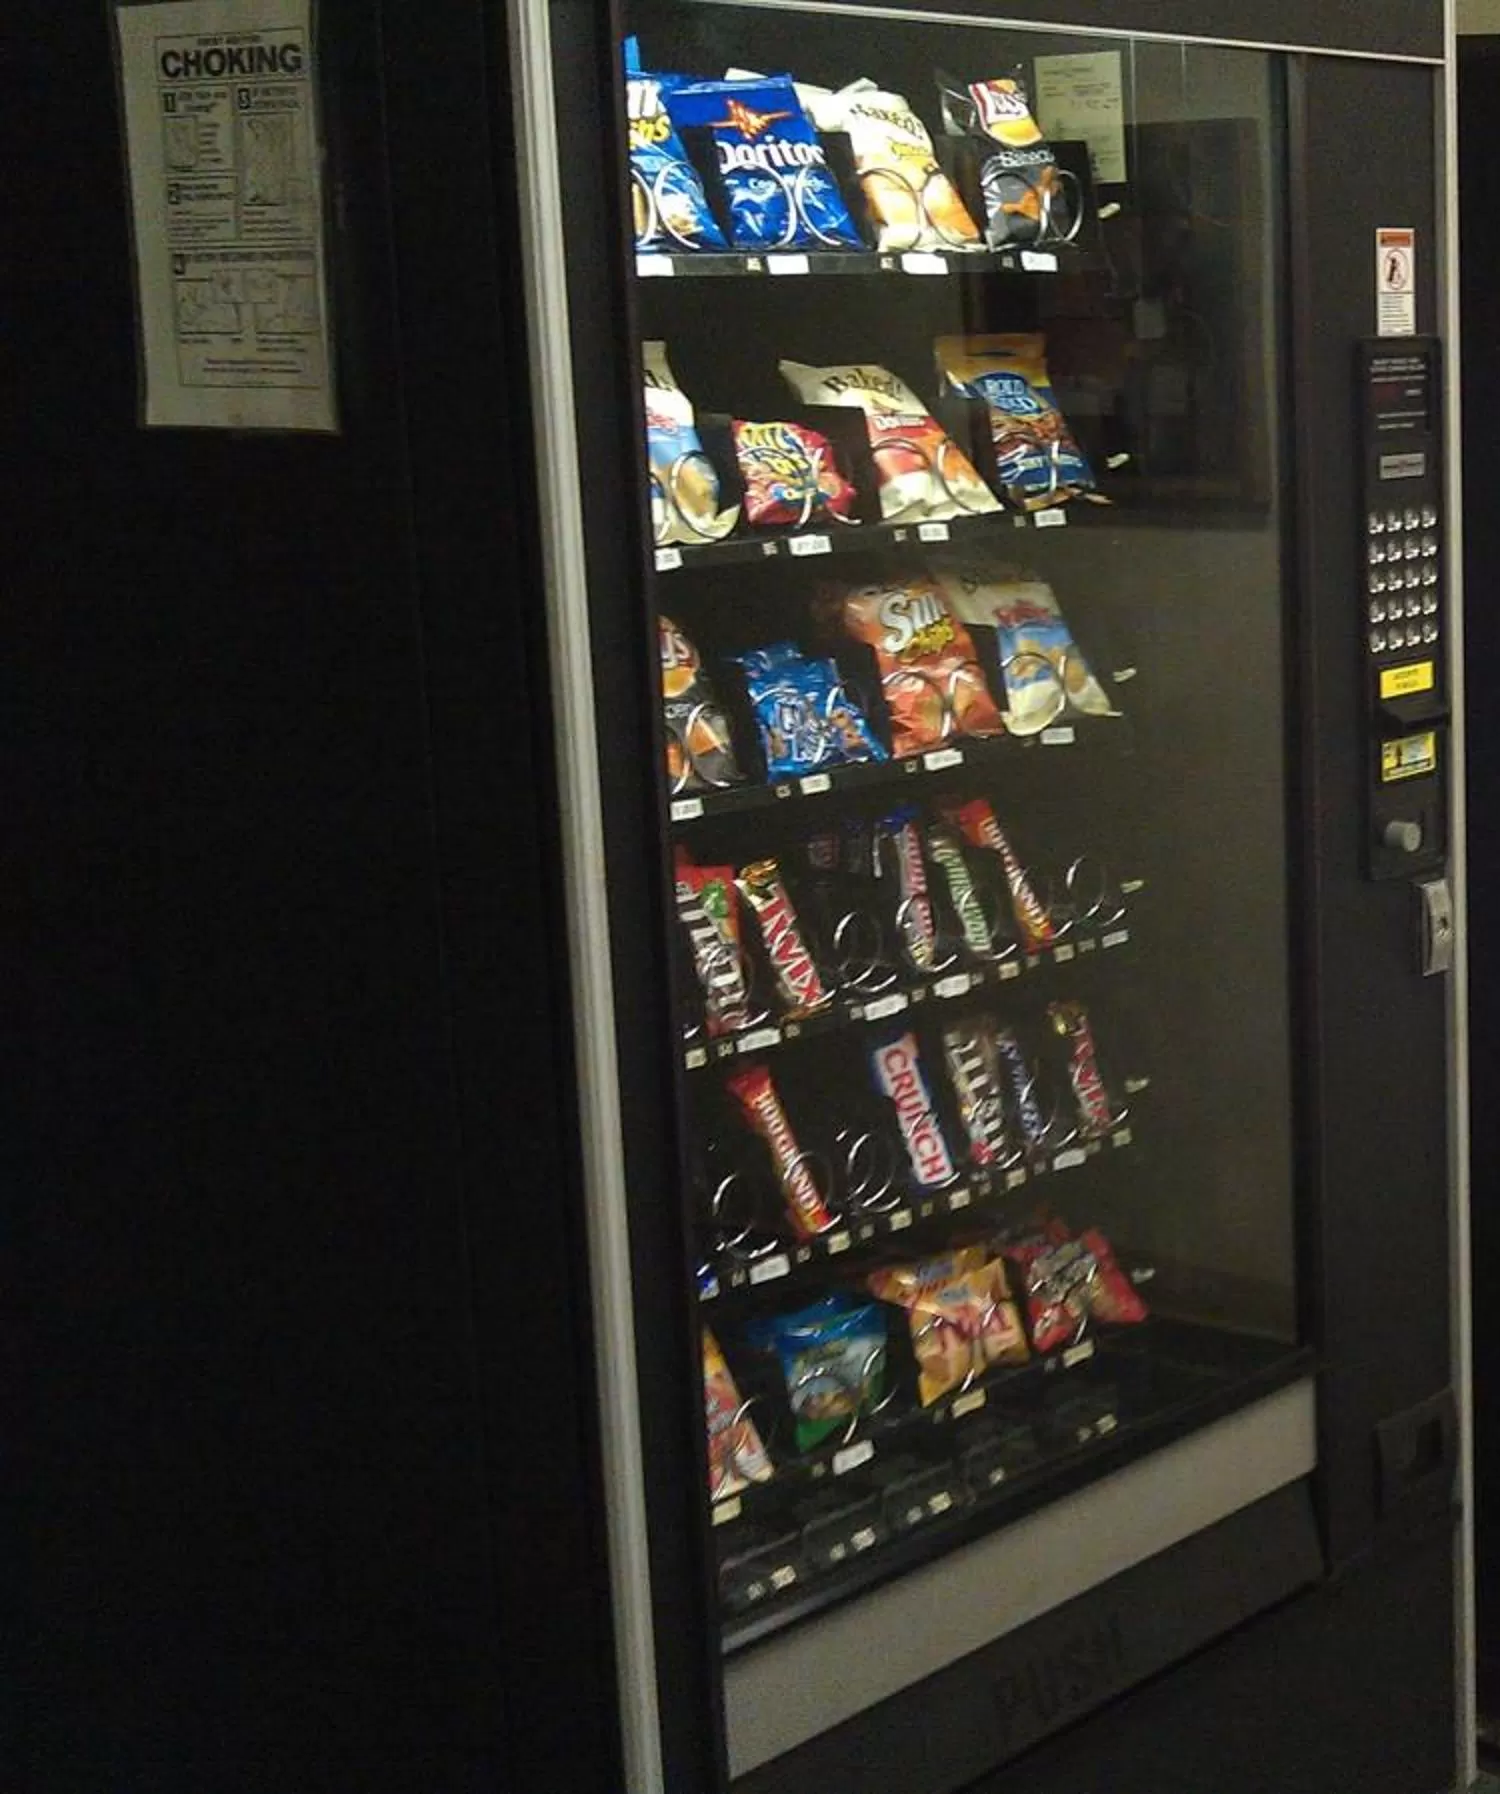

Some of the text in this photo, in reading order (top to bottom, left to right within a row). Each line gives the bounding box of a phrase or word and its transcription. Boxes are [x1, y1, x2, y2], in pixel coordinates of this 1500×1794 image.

[161, 43, 303, 77] CHOKING
[716, 135, 826, 176] Doritos
[884, 1047, 945, 1179] CRUNCH
